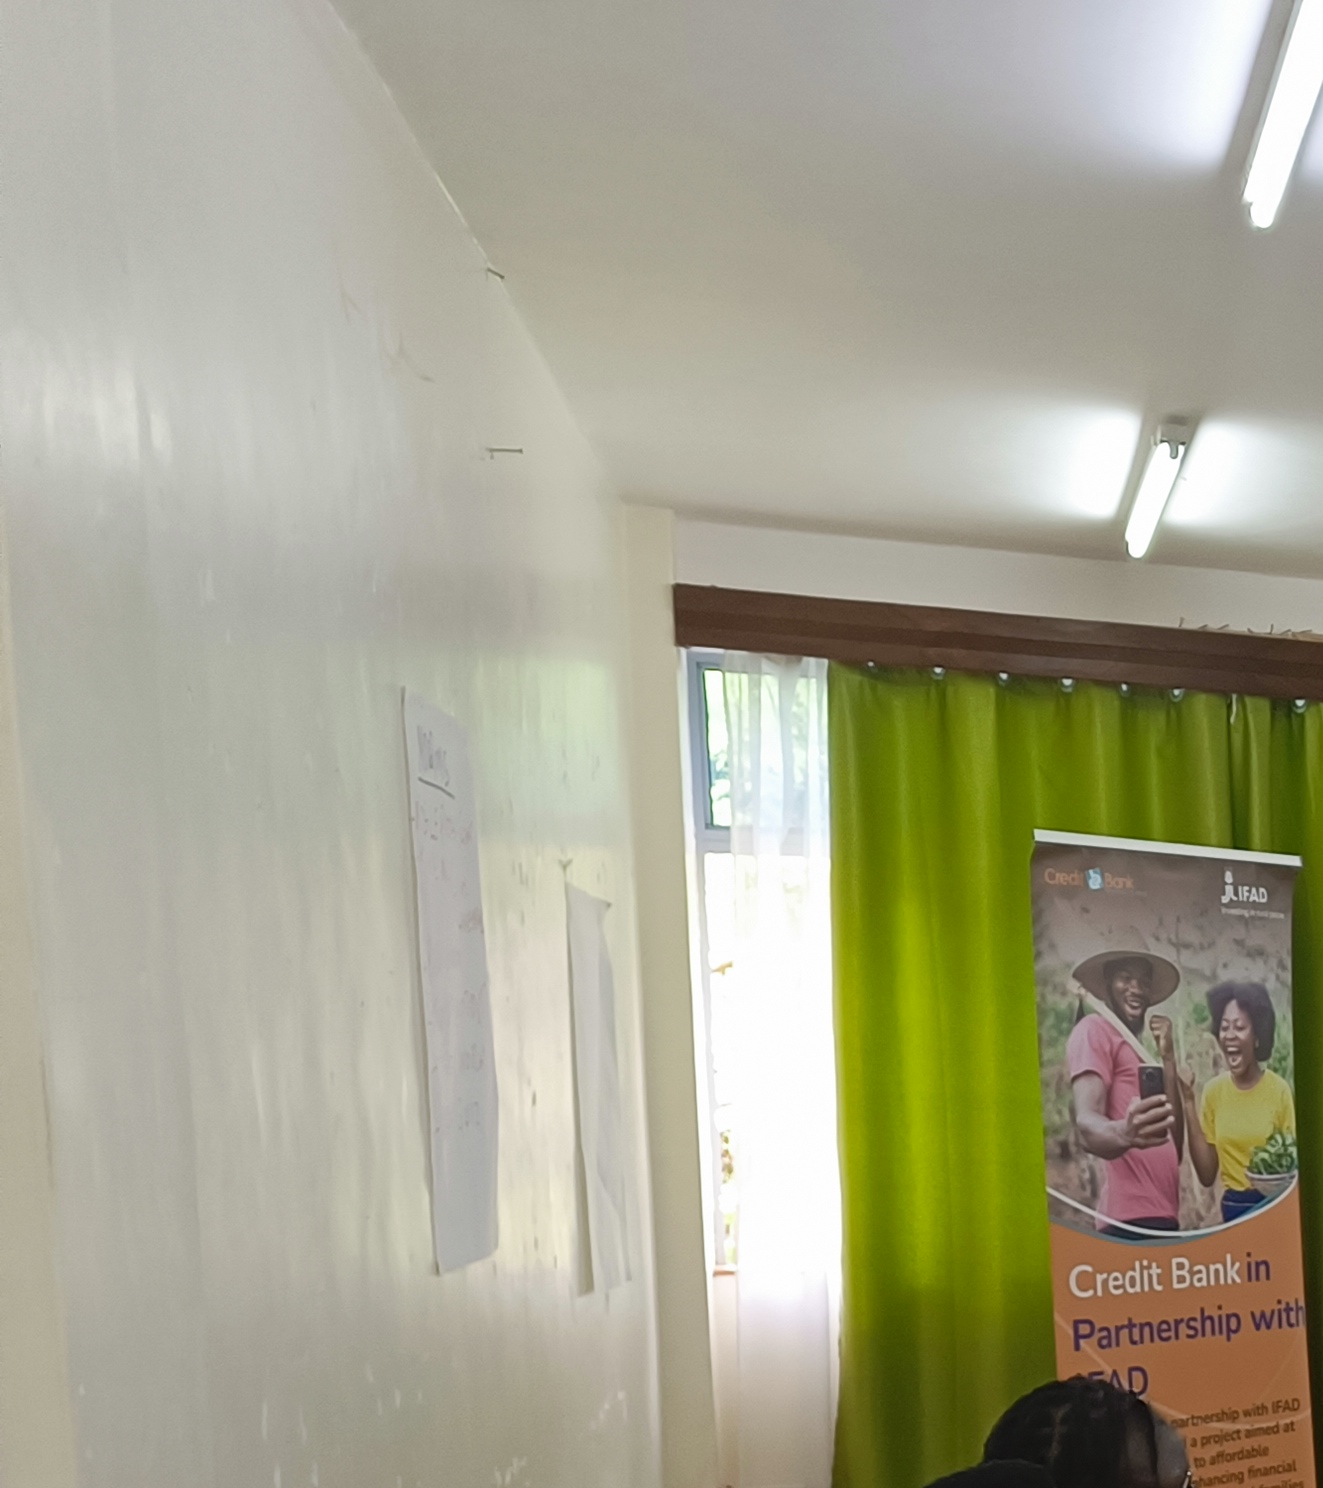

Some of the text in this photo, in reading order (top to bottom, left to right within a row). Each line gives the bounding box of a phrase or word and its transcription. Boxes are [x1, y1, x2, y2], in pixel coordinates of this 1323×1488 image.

[1104, 873, 1134, 889] Bank
[1238, 886, 1268, 903] IFAD
[1068, 1252, 1271, 1298] Credit Bank in
[1072, 1297, 1306, 1352] Partnership with
[1242, 1402, 1269, 1418] with
[1271, 1398, 1300, 1414] IFAD
[1200, 1428, 1242, 1451] project
[1245, 1423, 1280, 1440] aimed
[1282, 1420, 1296, 1433] at
[1194, 1444, 1270, 1469] to affordable
[1247, 1459, 1298, 1479] financial
